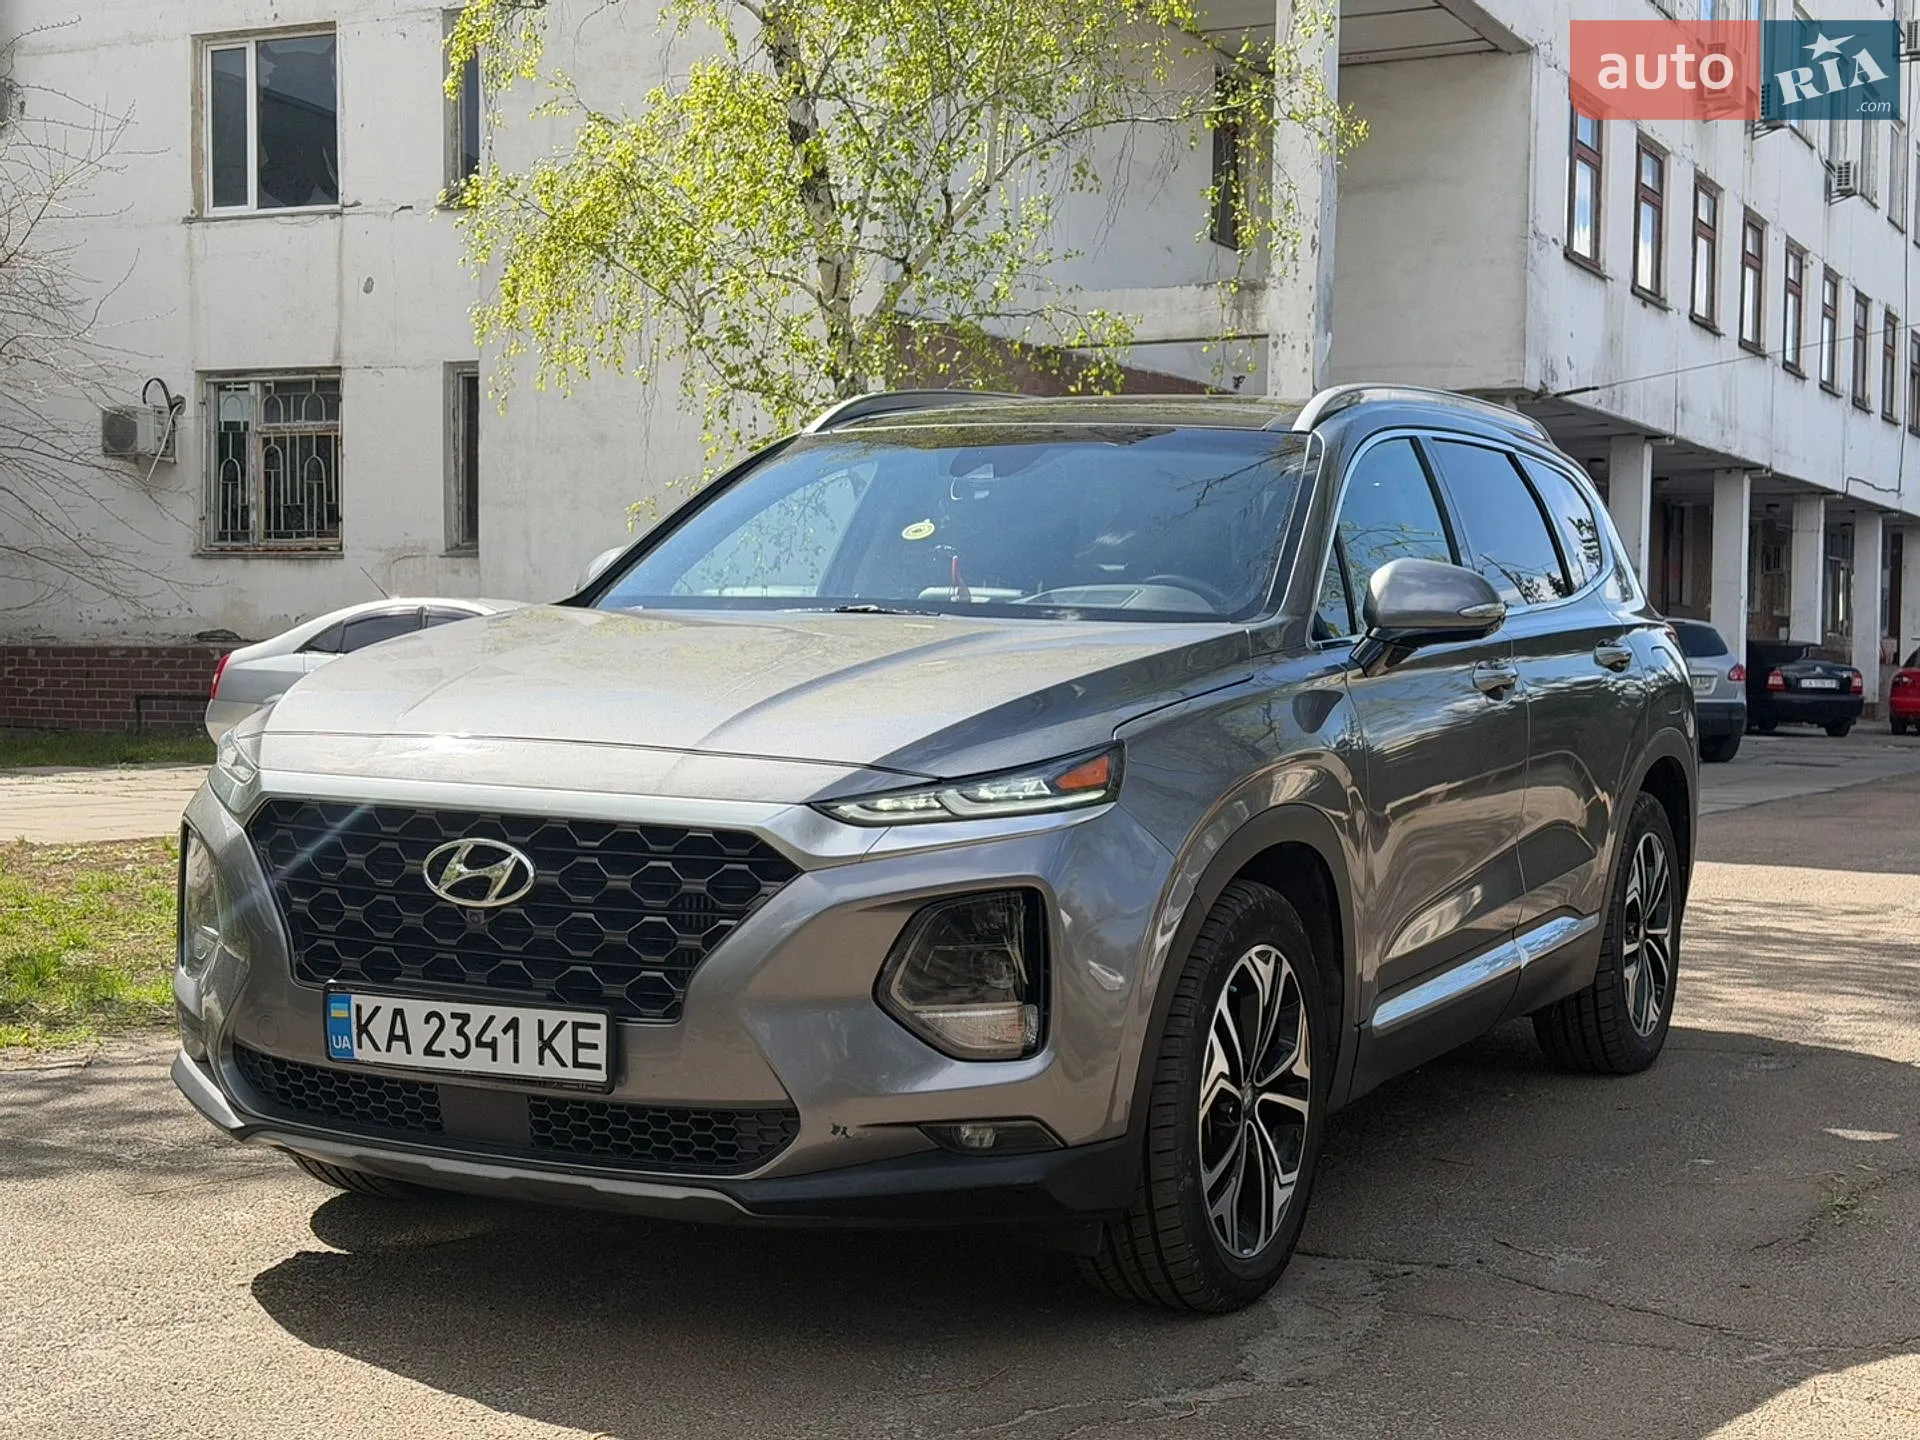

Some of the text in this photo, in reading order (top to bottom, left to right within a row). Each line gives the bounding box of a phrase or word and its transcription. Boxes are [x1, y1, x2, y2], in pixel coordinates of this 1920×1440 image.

[331, 1034, 351, 1050] UA
[355, 1003, 603, 1071] KA 2341 KE
